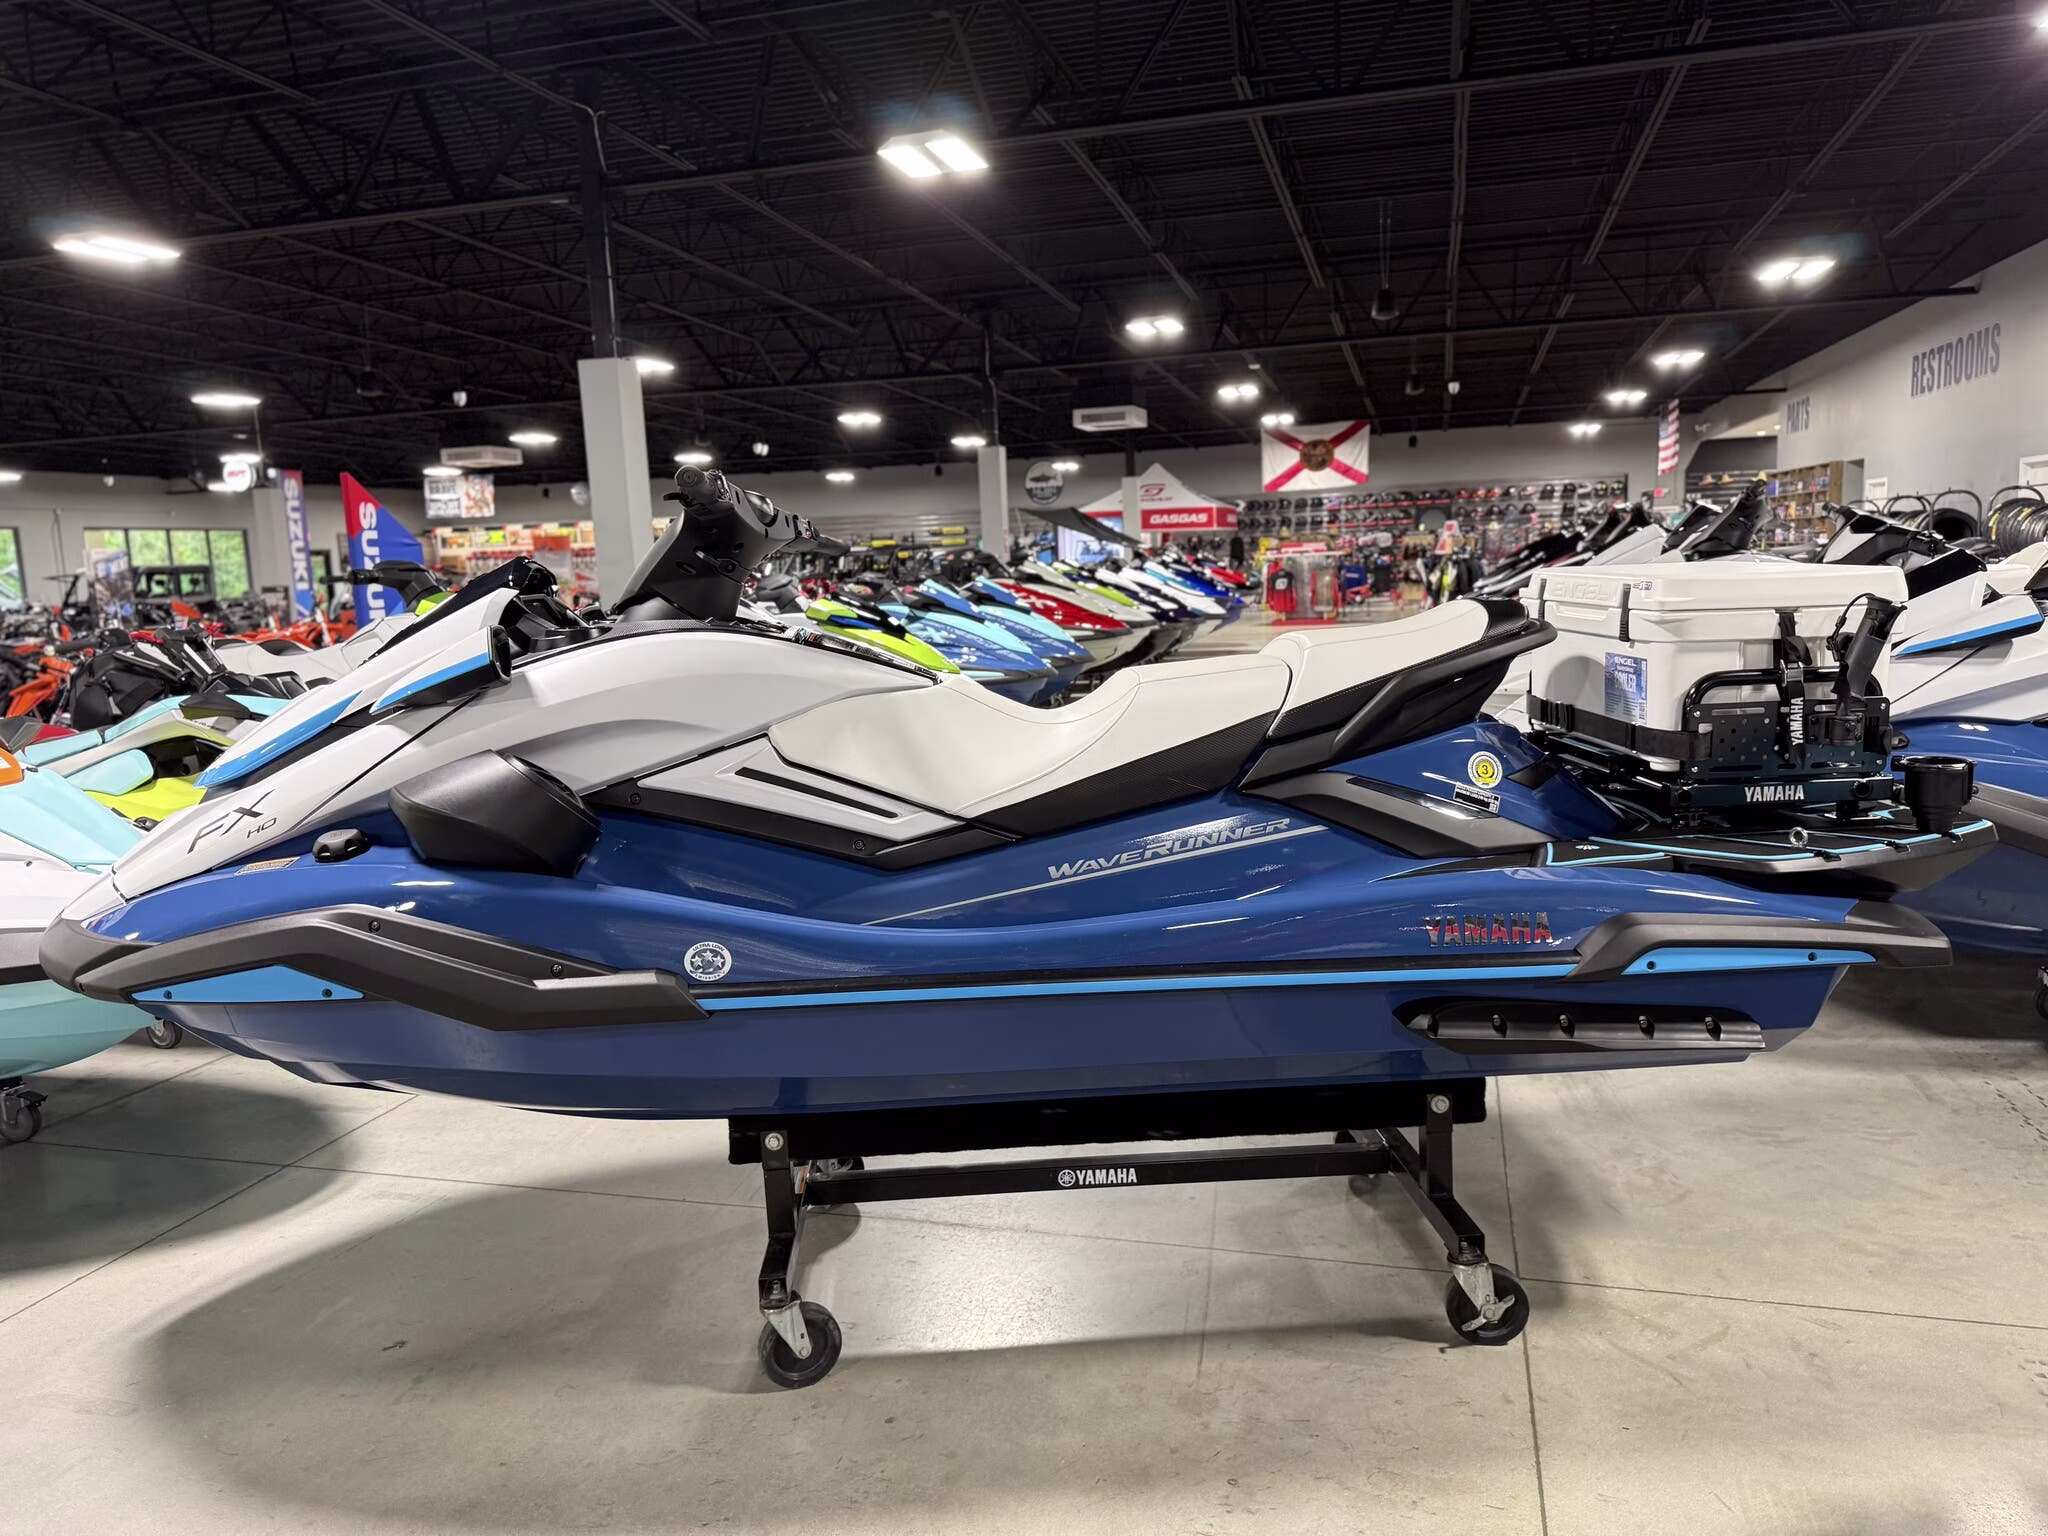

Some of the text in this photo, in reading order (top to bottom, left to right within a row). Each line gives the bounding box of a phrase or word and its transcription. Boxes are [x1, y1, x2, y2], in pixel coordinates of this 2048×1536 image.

[1911, 323, 2001, 397] RESTROOMS
[1786, 396, 1810, 435] PARTS
[283, 478, 310, 591] SUZUKI
[1150, 512, 1209, 525] GASGAS
[358, 501, 387, 622] SUZU
[1614, 655, 1637, 667] ENGEL
[1789, 697, 1805, 746] YAMAHA
[1481, 764, 1489, 775] 3
[1744, 784, 1805, 802] YAMAHA
[187, 788, 277, 855] FX
[247, 817, 277, 839] HO
[1423, 911, 1554, 947] YAMAHA
[1076, 1167, 1138, 1186] YAMAHA
